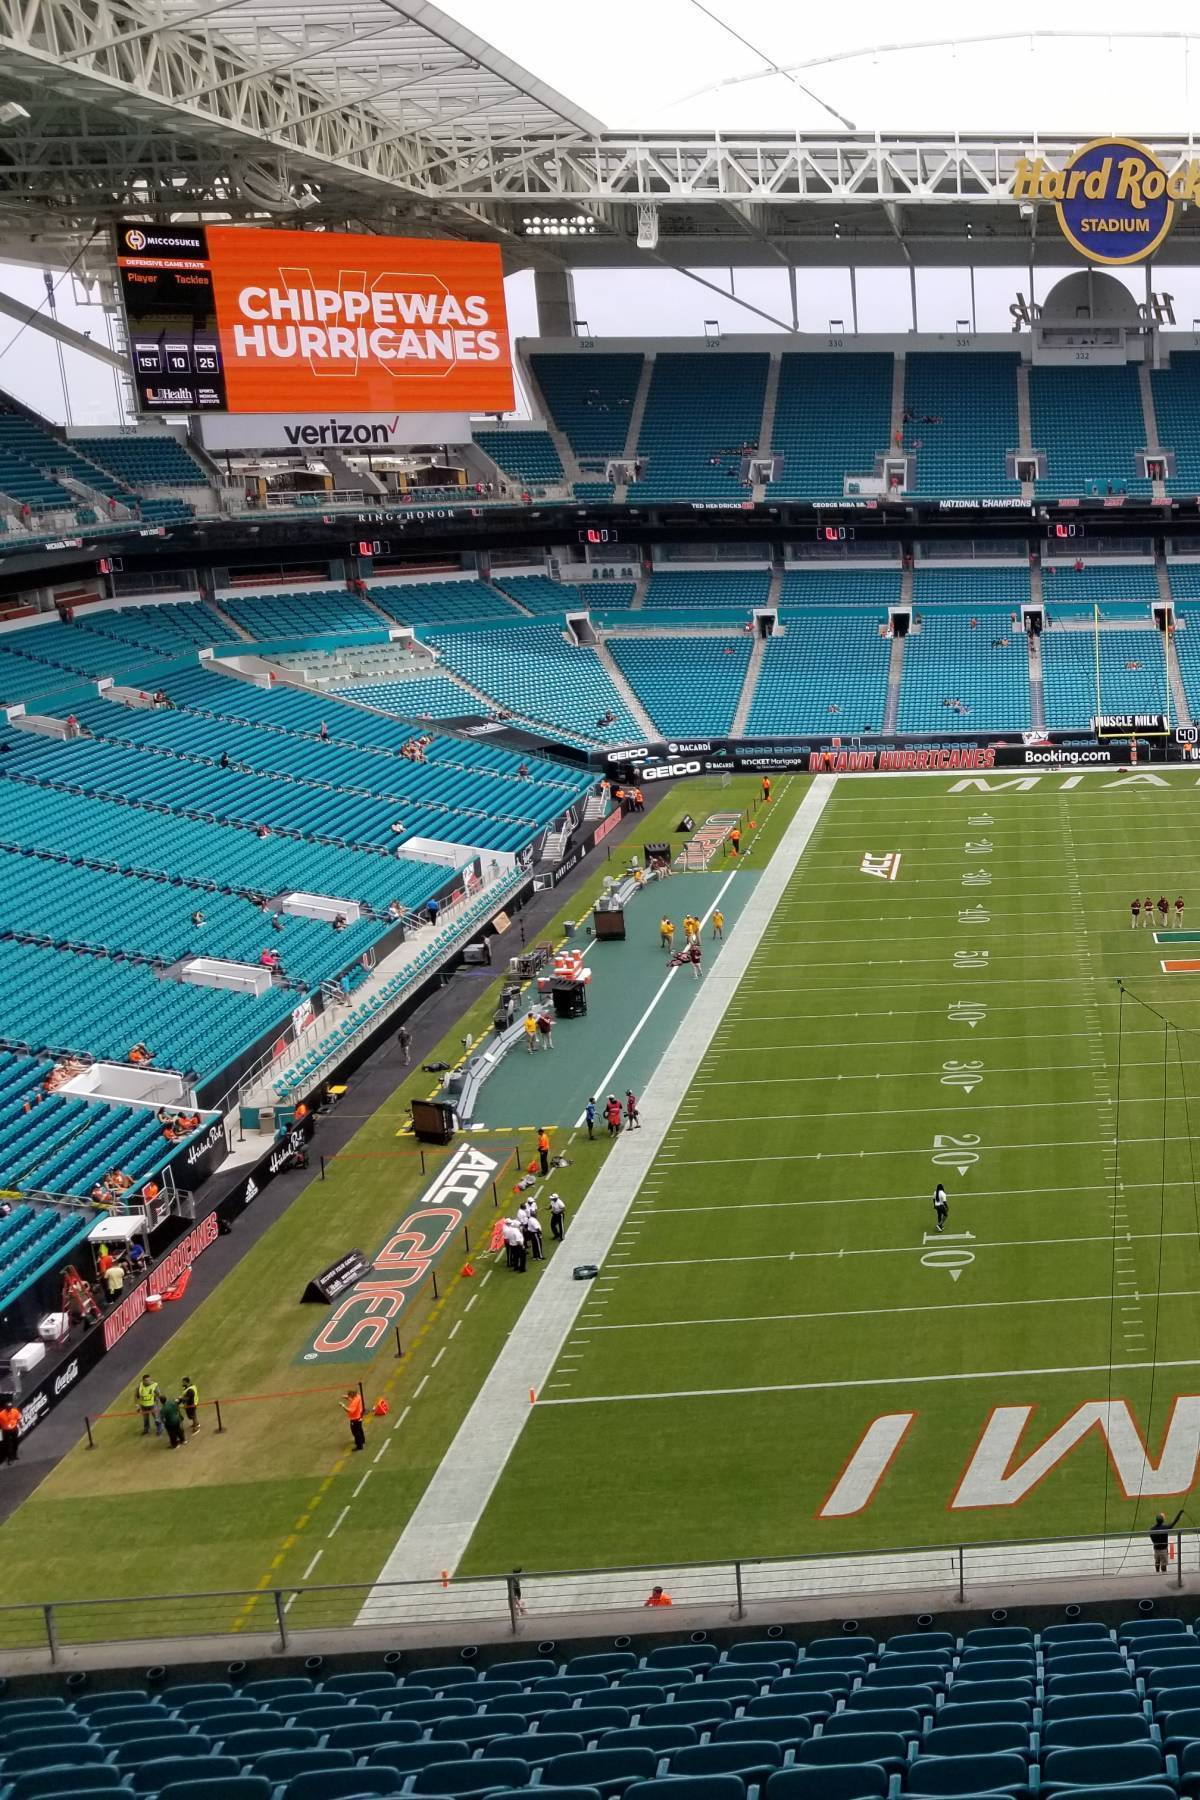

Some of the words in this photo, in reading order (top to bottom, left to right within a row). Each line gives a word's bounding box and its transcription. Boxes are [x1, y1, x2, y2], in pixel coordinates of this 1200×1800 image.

[1013, 157, 1112, 200] Hard
[1080, 218, 1150, 232] STADIUM
[147, 237, 200, 247] MICCOSUKEE
[127, 273, 158, 284] Player
[174, 274, 209, 285] Tackles
[238, 286, 490, 327] CHIPPEWAS
[233, 324, 501, 361] HURRICANES
[706, 340, 720, 349] 329
[828, 339, 844, 348] 330
[956, 339, 971, 348] 331
[140, 357, 159, 368] 1ST
[171, 357, 186, 369] 10
[199, 357, 215, 369] 25
[284, 419, 390, 445] verizon
[939, 500, 980, 509] NATIONAL
[981, 498, 1032, 508] CHAMPIONS
[358, 511, 394, 523] RING
[406, 509, 456, 520] HONOR
[1095, 715, 1132, 728] MUSCLE
[1133, 714, 1159, 727] MILK
[1179, 728, 1196, 742] 40
[607, 747, 649, 761] GEICO
[680, 742, 711, 752] BACARDÍ
[741, 758, 770, 766] ROCKET
[770, 758, 802, 767] Mortgage
[878, 748, 997, 772] HURRICANES
[1024, 750, 1111, 765] Booking.com
[642, 761, 701, 780] GEICO
[421, 1143, 499, 1207] ACC
[103, 1279, 148, 1351] MIAMI
[149, 1211, 219, 1295] HURRICANES
